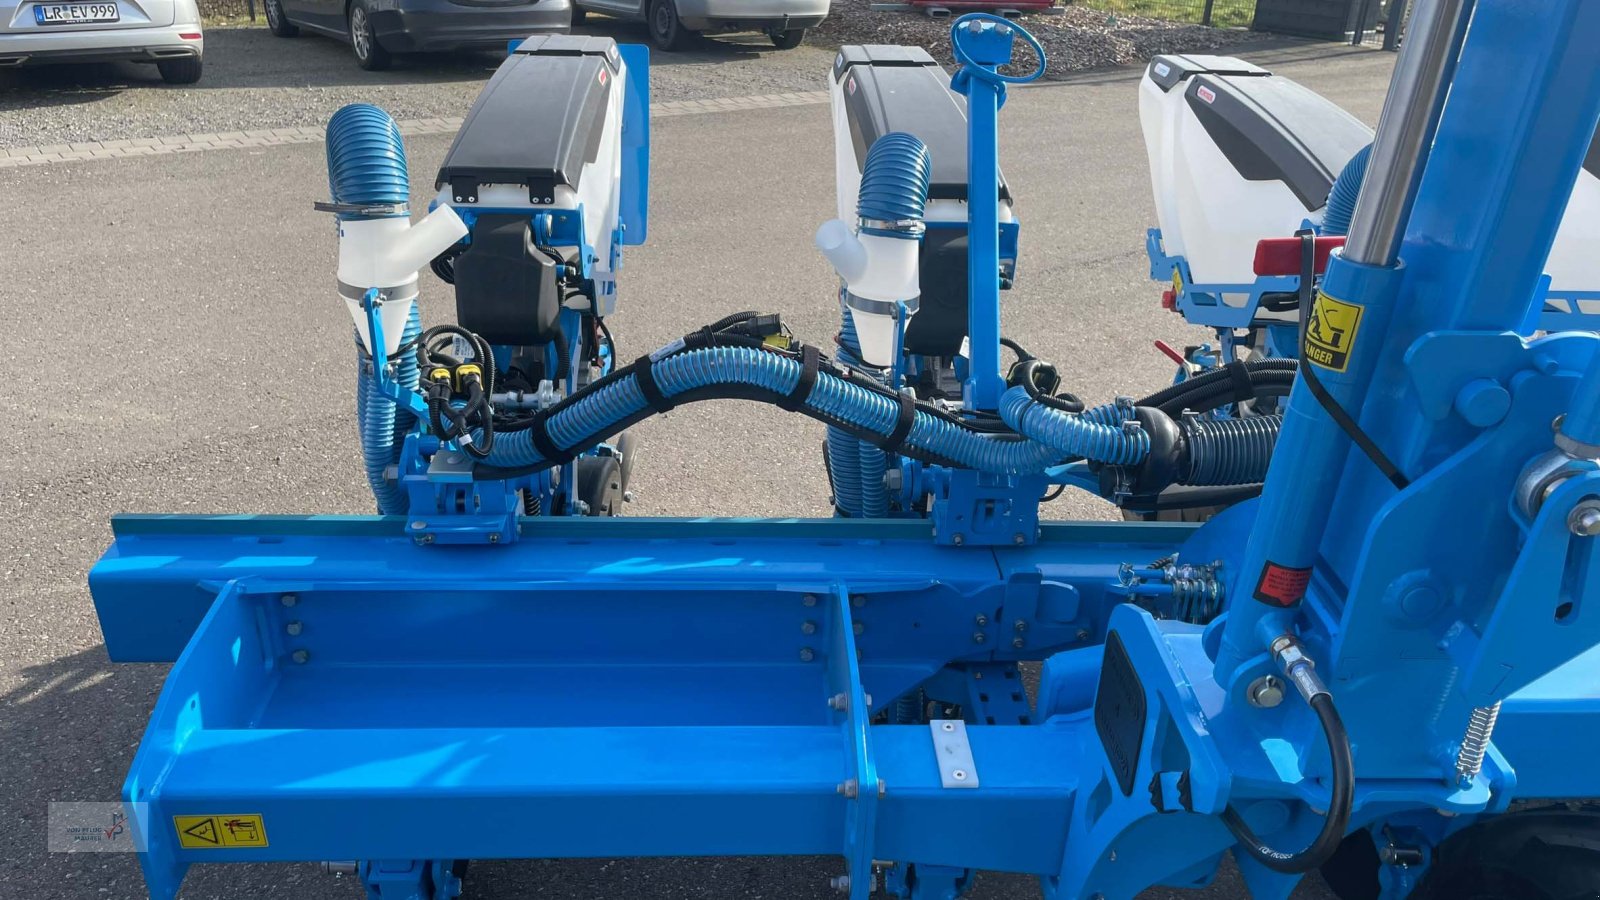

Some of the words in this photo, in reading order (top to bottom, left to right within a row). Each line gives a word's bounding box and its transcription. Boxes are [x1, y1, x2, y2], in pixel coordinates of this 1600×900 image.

[43, 7, 62, 19] LR
[70, 6, 87, 18] EV
[91, 5, 115, 17] 999
[1305, 341, 1333, 364] ANGER
